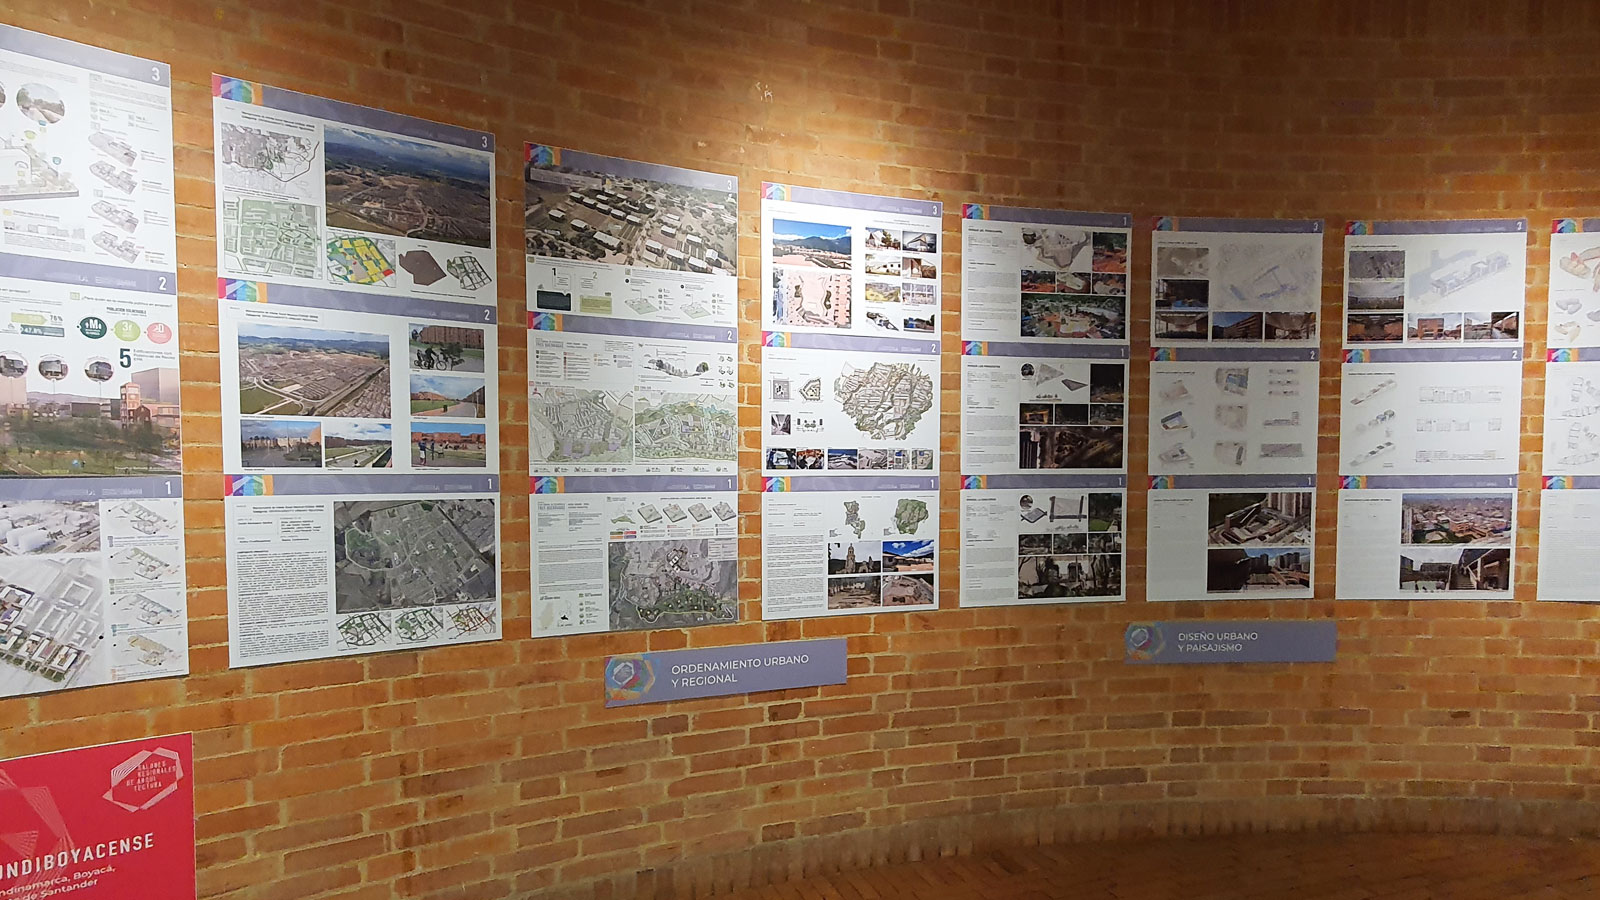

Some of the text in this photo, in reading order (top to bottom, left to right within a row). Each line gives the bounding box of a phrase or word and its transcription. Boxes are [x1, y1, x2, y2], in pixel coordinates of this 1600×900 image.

[151, 67, 161, 82] 3
[482, 135, 488, 148] 3
[727, 180, 732, 191] 3
[932, 205, 938, 215] 3
[158, 277, 167, 291] 2
[484, 309, 490, 321] 2
[727, 330, 732, 341] 2
[931, 343, 936, 353] 2
[119, 347, 132, 369] 5
[1310, 350, 1315, 360] 2
[1512, 350, 1518, 359] 2
[165, 481, 172, 495] 1
[488, 478, 493, 489] 1
[727, 479, 732, 489] 1
[930, 479, 935, 489] 1
[1178, 631, 1258, 641] DISEÑO URBANO
[1178, 643, 1243, 652] Y PAISAJISMO
[671, 654, 809, 675] ORDENAMIENTO URBANO
[671, 673, 738, 688] Y REGIONAL
[0, 832, 154, 880] NDIBOYACENSE
[73, 864, 116, 880] Boyacá,
[41, 879, 98, 899] Santander
